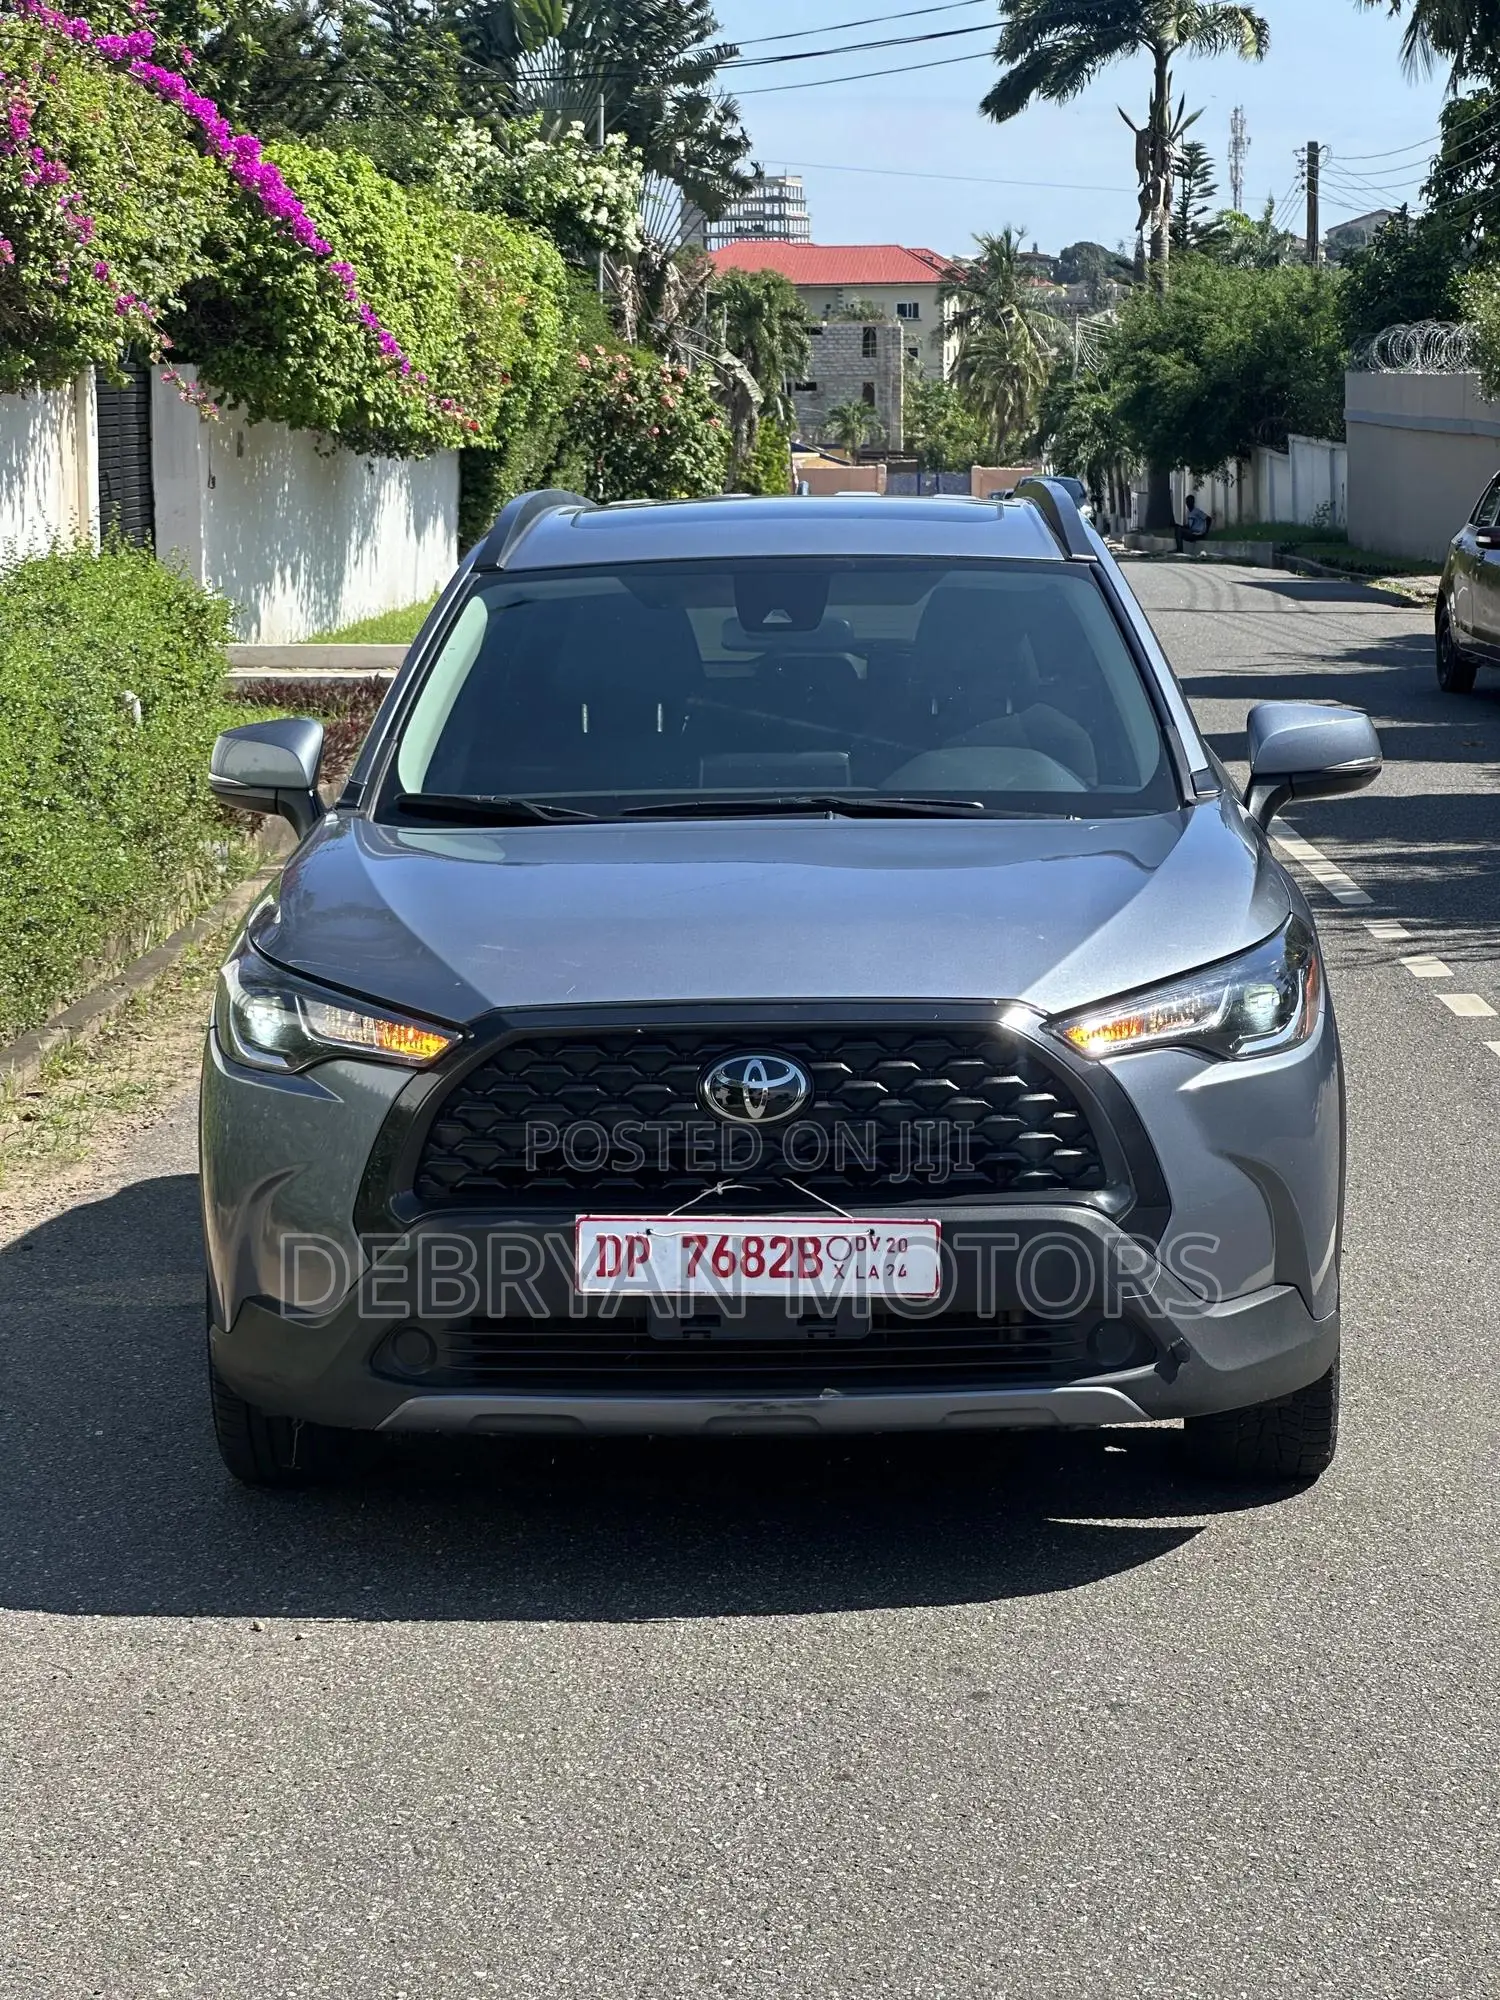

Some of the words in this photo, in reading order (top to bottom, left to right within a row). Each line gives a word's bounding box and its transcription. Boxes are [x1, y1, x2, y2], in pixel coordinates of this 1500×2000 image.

[855, 1236, 880, 1252] DV
[886, 1237, 909, 1253] 20
[595, 1233, 652, 1278] DP
[681, 1234, 824, 1279] 7682B
[856, 1264, 880, 1279] LA
